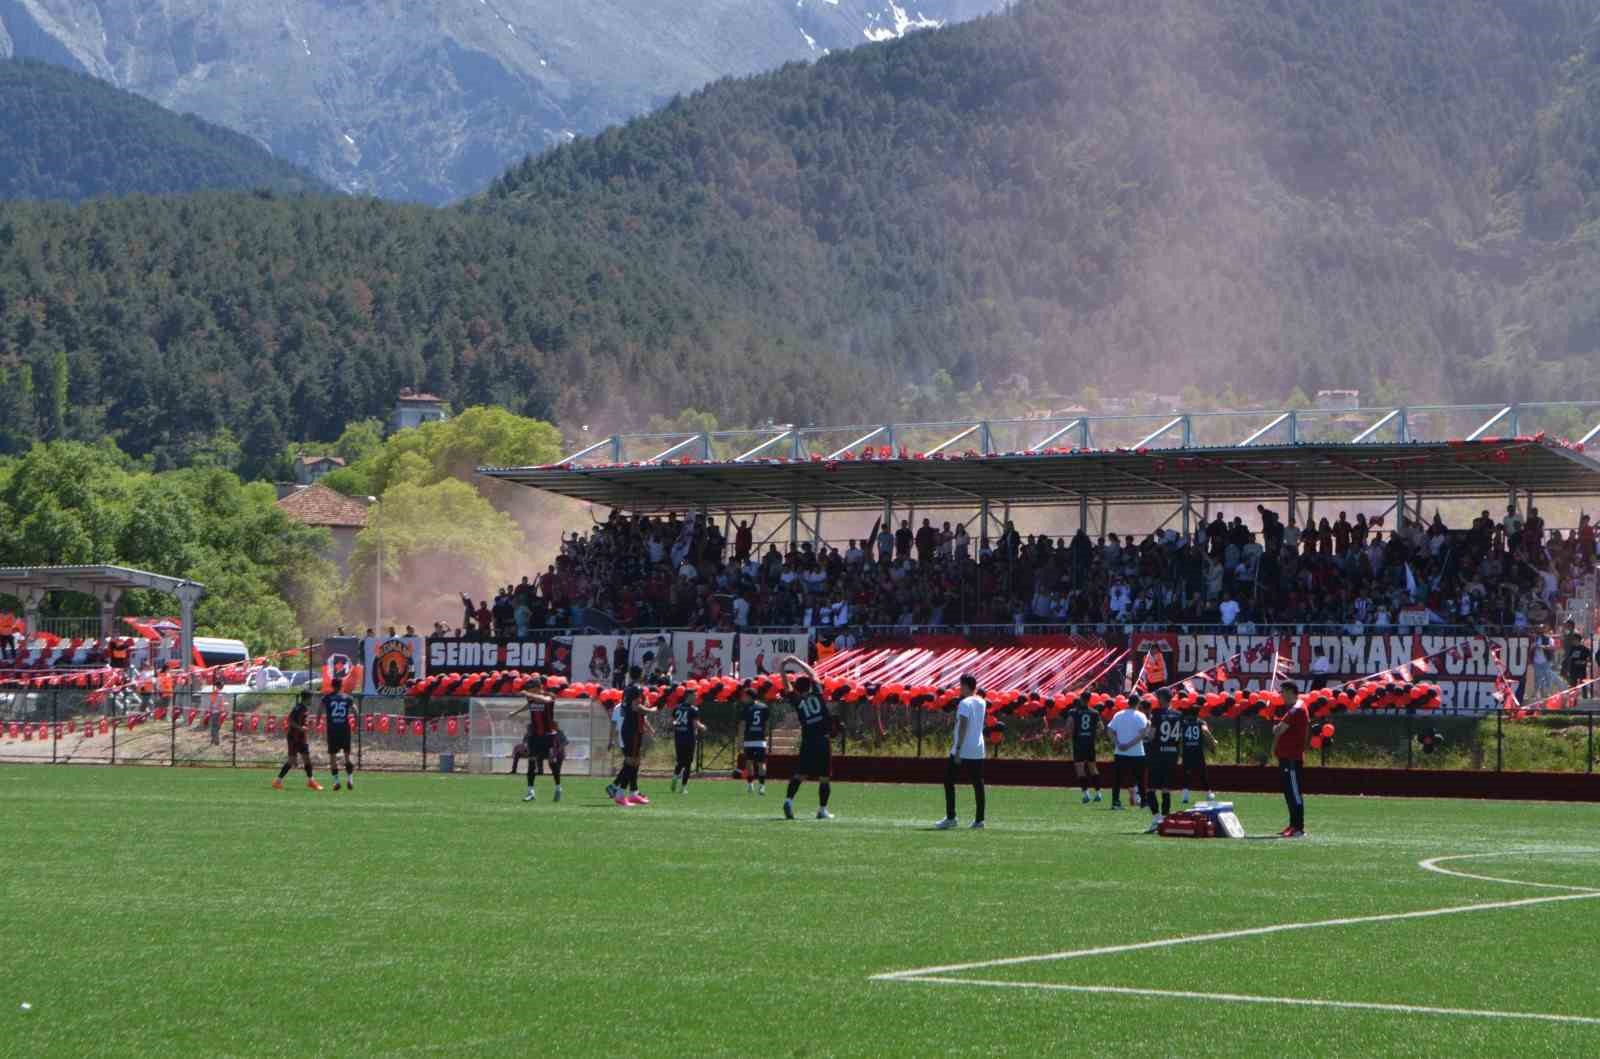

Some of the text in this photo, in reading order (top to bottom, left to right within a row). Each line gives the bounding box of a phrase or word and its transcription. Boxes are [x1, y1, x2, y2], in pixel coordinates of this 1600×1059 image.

[505, 642, 546, 666] 20!
[1421, 636, 1529, 676] YURDU
[330, 701, 346, 716] 25
[799, 696, 821, 718] 10
[675, 710, 689, 725] 24
[752, 710, 761, 725] 5
[1081, 714, 1090, 730] 8
[1160, 721, 1181, 742] 94
[1185, 725, 1200, 741] 49
